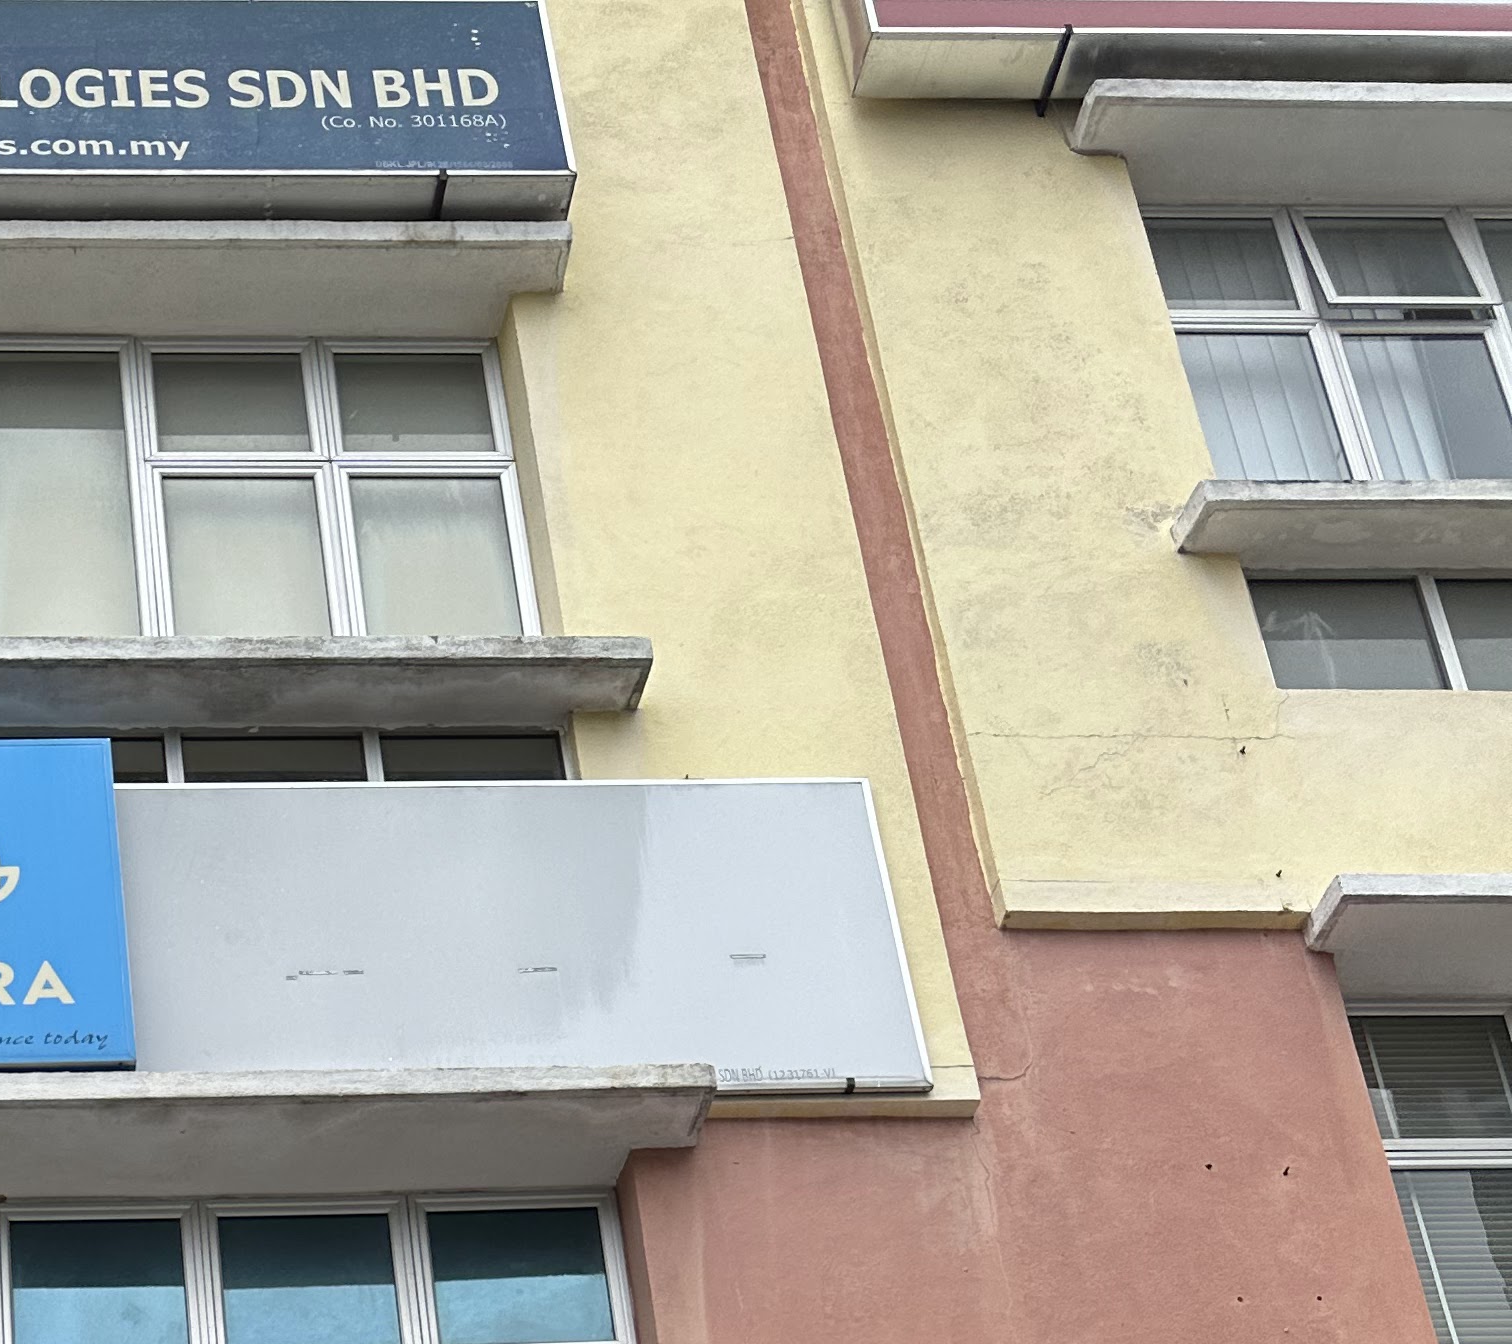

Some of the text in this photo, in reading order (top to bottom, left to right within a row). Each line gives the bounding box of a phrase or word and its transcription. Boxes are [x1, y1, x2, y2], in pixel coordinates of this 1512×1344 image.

[228, 69, 353, 109] SDN
[375, 69, 500, 108] BHD
[321, 114, 507, 131] (Co. No. 301168A)
[43, 1031, 110, 1051] today
[718, 1068, 738, 1083] SDN
[741, 1066, 763, 1082] BHD
